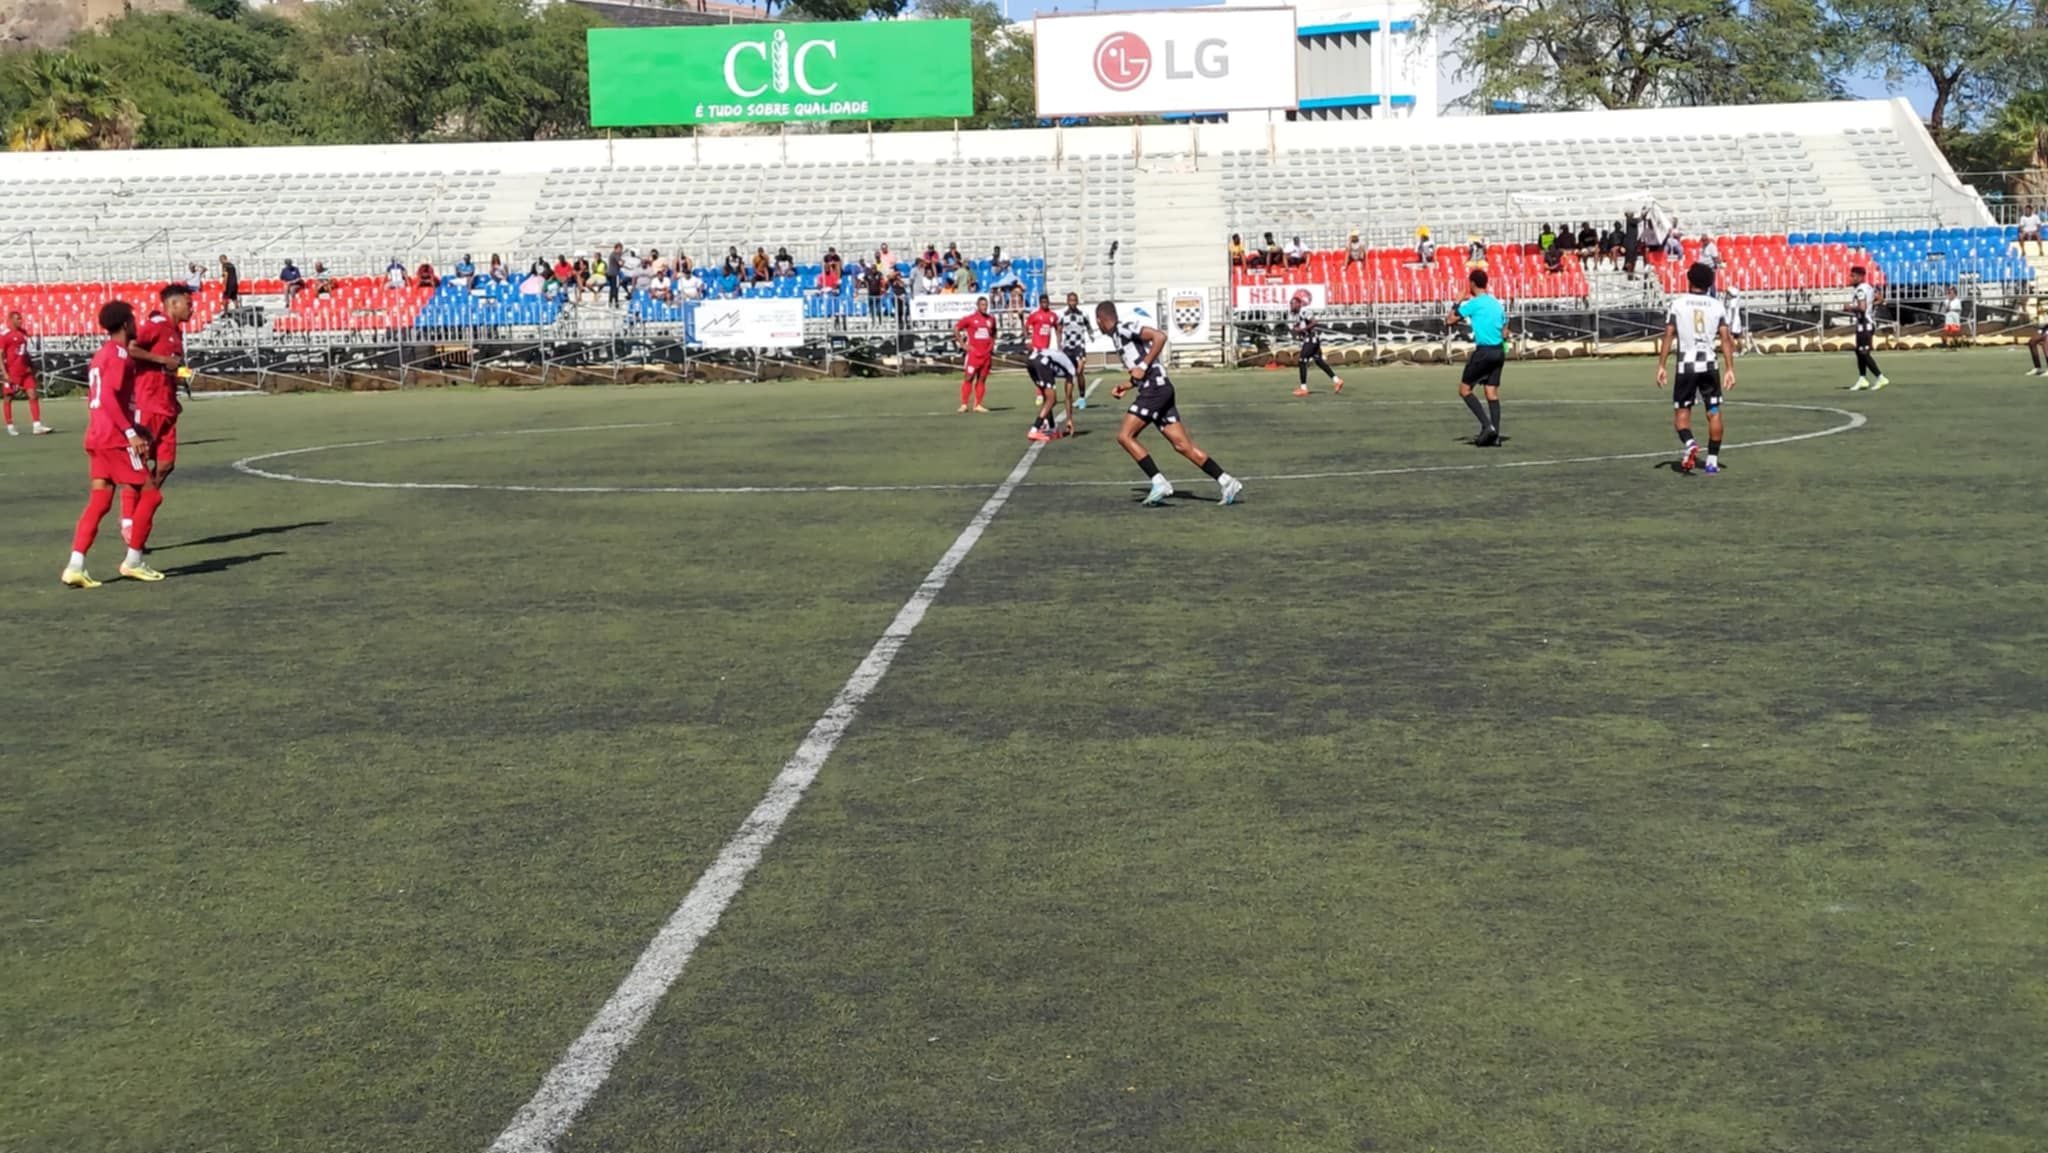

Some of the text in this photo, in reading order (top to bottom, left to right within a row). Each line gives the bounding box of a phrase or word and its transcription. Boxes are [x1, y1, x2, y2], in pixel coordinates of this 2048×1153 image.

[1164, 38, 1229, 80] LG
[695, 101, 869, 118] É TUDO SOBRE QUALIDADE
[1249, 287, 1288, 304] HELL
